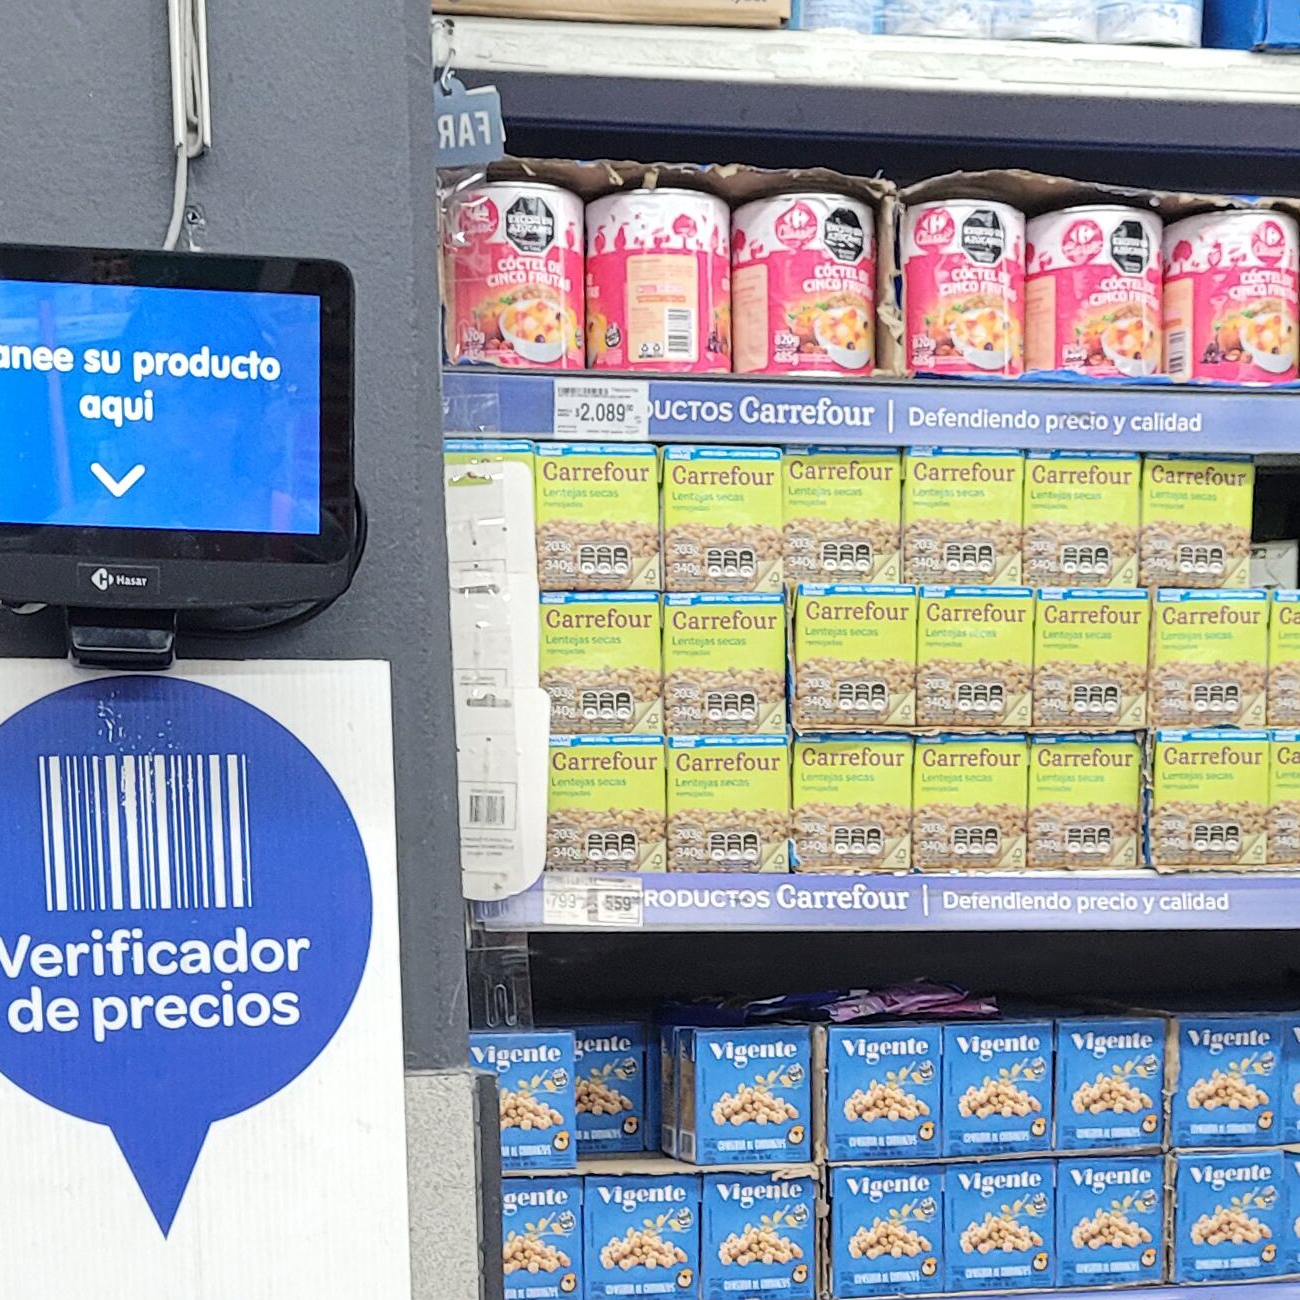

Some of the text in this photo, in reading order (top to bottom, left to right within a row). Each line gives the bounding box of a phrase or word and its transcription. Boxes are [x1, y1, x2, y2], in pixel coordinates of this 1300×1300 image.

[487, 272, 527, 287] CINCO
[84, 350, 120, 373] su
[133, 348, 280, 382] producto
[80, 390, 153, 427] aqui
[575, 403, 626, 423] $2.089
[740, 397, 874, 426] Carrefour
[909, 407, 1039, 429] Defendiendo
[1045, 410, 1108, 434] precio
[1113, 415, 1126, 435] y
[1130, 411, 1201, 432] calidad
[543, 462, 649, 483] Carrefour
[672, 466, 775, 487] Carrefour
[789, 461, 893, 481] Carrefour
[1032, 465, 1133, 486] Carrefour
[1151, 465, 1246, 486] Carrefour
[543, 487, 619, 500] Lentejas secas
[672, 491, 744, 504] Lentejas secas
[117, 574, 147, 587] Hasar
[546, 609, 652, 629] Carrefour
[673, 612, 777, 631] Carrefour
[806, 602, 909, 621] Carrefour
[1045, 606, 1141, 626] Carrefour
[553, 751, 658, 771] Carrefour
[676, 754, 780, 772] Carrefour
[1164, 747, 1263, 766] Carrefour
[777, 884, 909, 909] Carrefour
[943, 892, 1071, 910] Defendiendo
[1078, 894, 1138, 913] precio
[1143, 894, 1153, 914] y
[1159, 892, 1229, 911] calidad
[8, 980, 300, 1041] de precios
[842, 1039, 928, 1064] Vigente
[1071, 1032, 1153, 1057] Vigente
[1188, 1029, 1270, 1054] Vigente
[709, 1043, 797, 1068] Vigente
[1190, 1165, 1271, 1189] Vigente
[598, 1186, 685, 1211] Vigente
[847, 1176, 930, 1201] Vigente
